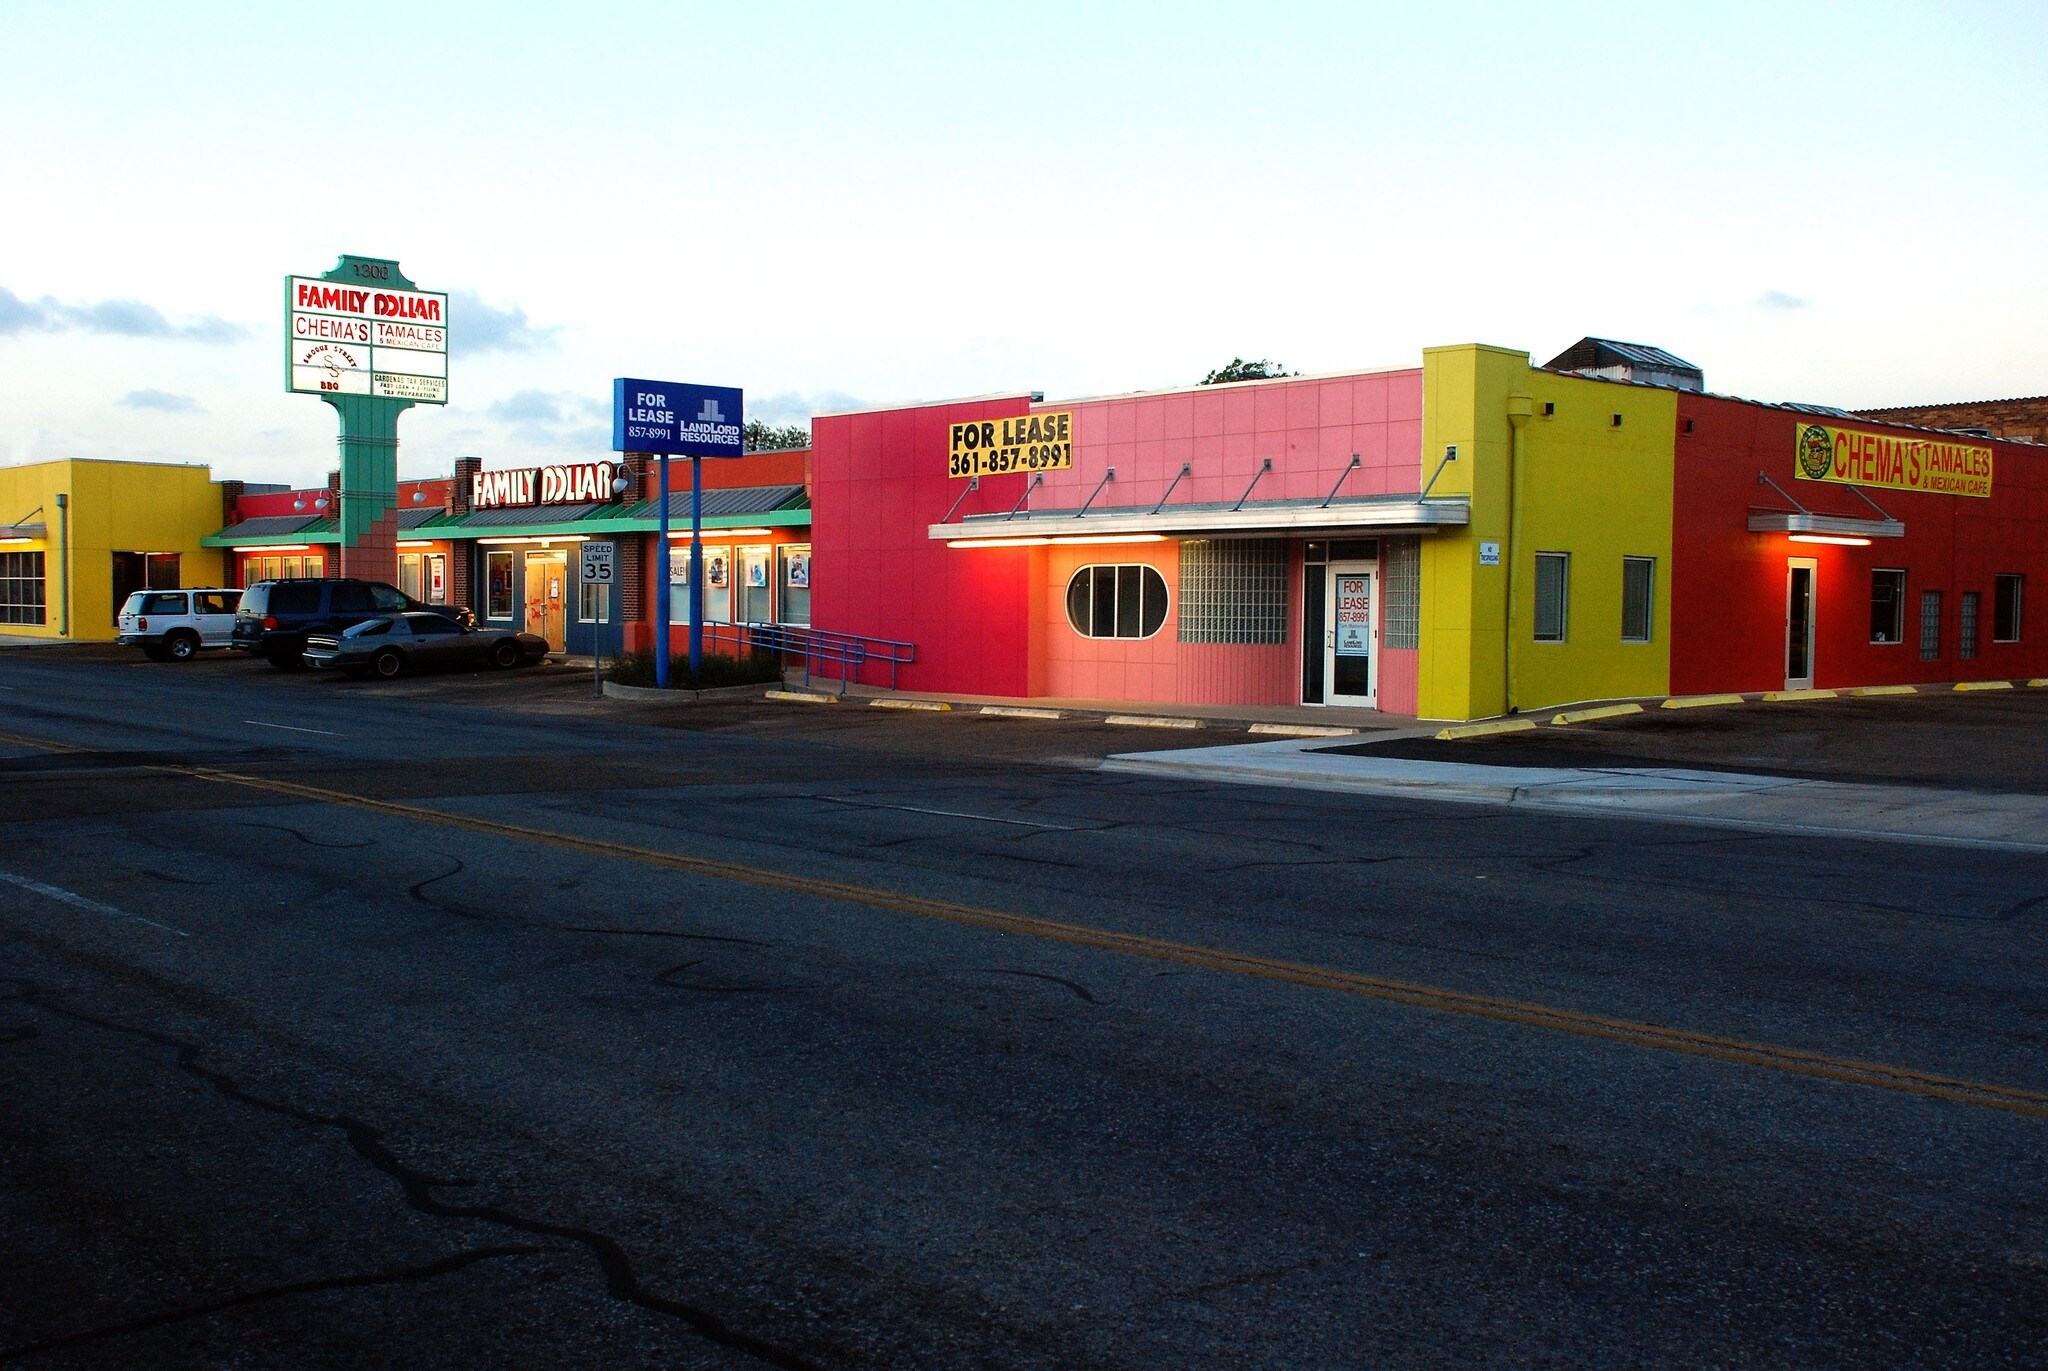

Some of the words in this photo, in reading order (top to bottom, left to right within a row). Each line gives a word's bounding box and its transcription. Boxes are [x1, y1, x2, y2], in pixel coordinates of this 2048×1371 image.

[353, 264, 389, 280] 1300
[298, 284, 370, 314] FAMILY
[374, 293, 440, 321] DOLLAR
[296, 317, 368, 342] CHEMA'S
[377, 323, 442, 342] TAMALES
[386, 338, 419, 348] MEXICAN
[421, 341, 440, 350] CAFE
[334, 346, 358, 367] STREET
[320, 380, 339, 391] BBQ
[637, 392, 666, 408] FOR
[628, 408, 674, 424] LEASE
[628, 426, 671, 440] 857-8991
[680, 420, 740, 435] LANDLORD
[953, 422, 995, 451] FOR
[1003, 414, 1068, 446] LEASE
[680, 432, 740, 445] RESOURCES
[950, 443, 1071, 475] 361-857-8991
[1833, 431, 1921, 486] CHEMA'S
[1923, 443, 1989, 477] TAMALES
[473, 469, 540, 508] FAMILY
[542, 461, 614, 505] DOLLAR
[1923, 476, 1928, 489] &
[1930, 476, 1966, 492] MEXICAN
[1967, 480, 1988, 495] CAFE
[584, 545, 613, 553] SPEED
[586, 554, 609, 562] LIMIT
[584, 563, 612, 579] 35
[1343, 580, 1363, 594] FOR
[1339, 597, 1368, 610] LEASE
[1339, 612, 1368, 623] 857-8991
